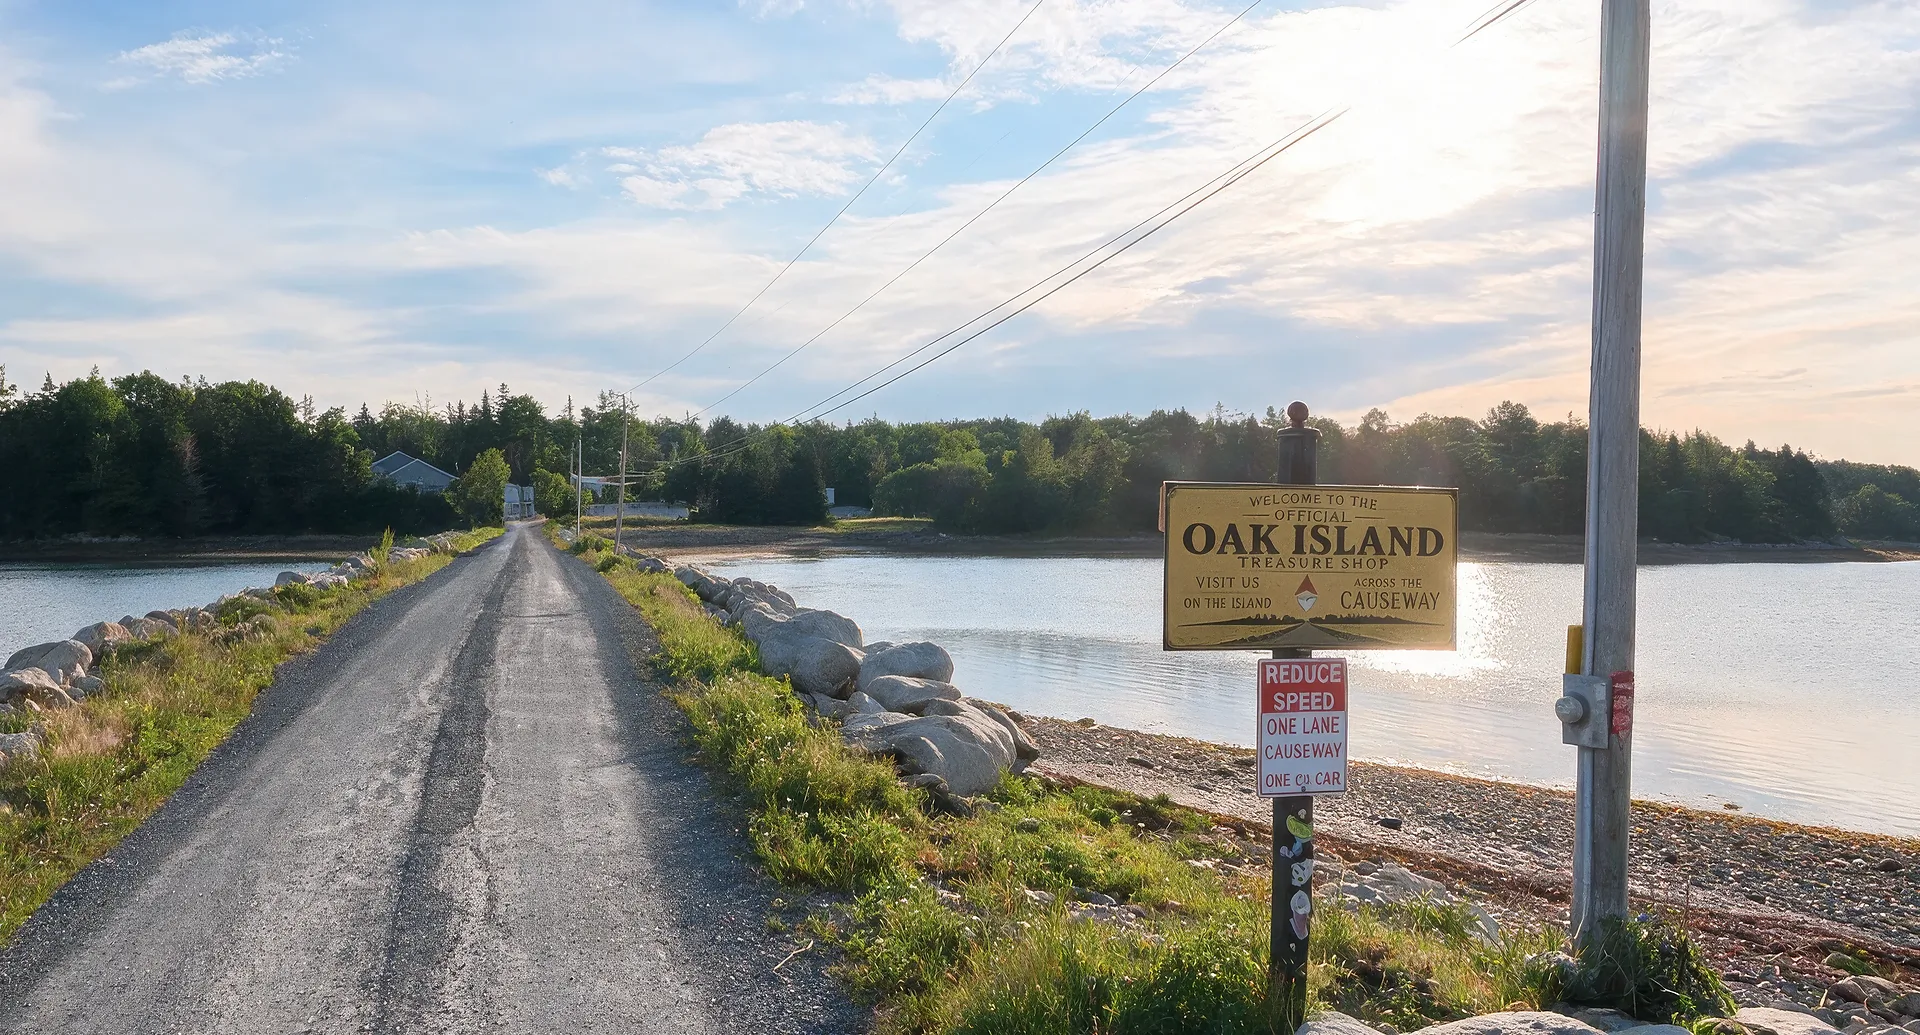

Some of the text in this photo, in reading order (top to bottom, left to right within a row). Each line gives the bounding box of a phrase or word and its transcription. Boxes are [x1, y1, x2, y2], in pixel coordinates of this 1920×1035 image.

[1249, 493, 1378, 510] WELCOME TO THE
[1274, 509, 1352, 523] OFFICIAL
[1182, 522, 1444, 557] OAK ISLAND
[1237, 556, 1389, 570] TREASURE SHOP
[1195, 576, 1260, 589] VISIT US
[1354, 578, 1422, 588] ACROSS THE
[1183, 597, 1272, 609] ON THE ISLAND
[1340, 590, 1440, 610] CAUSEWAY
[1265, 663, 1342, 684] REDUCE
[1273, 691, 1335, 711] SPEED
[1266, 716, 1340, 735] ONE LANE
[1264, 742, 1342, 760] CAUSEWAY
[1265, 773, 1291, 788] ONE
[1315, 771, 1341, 786] CAR
